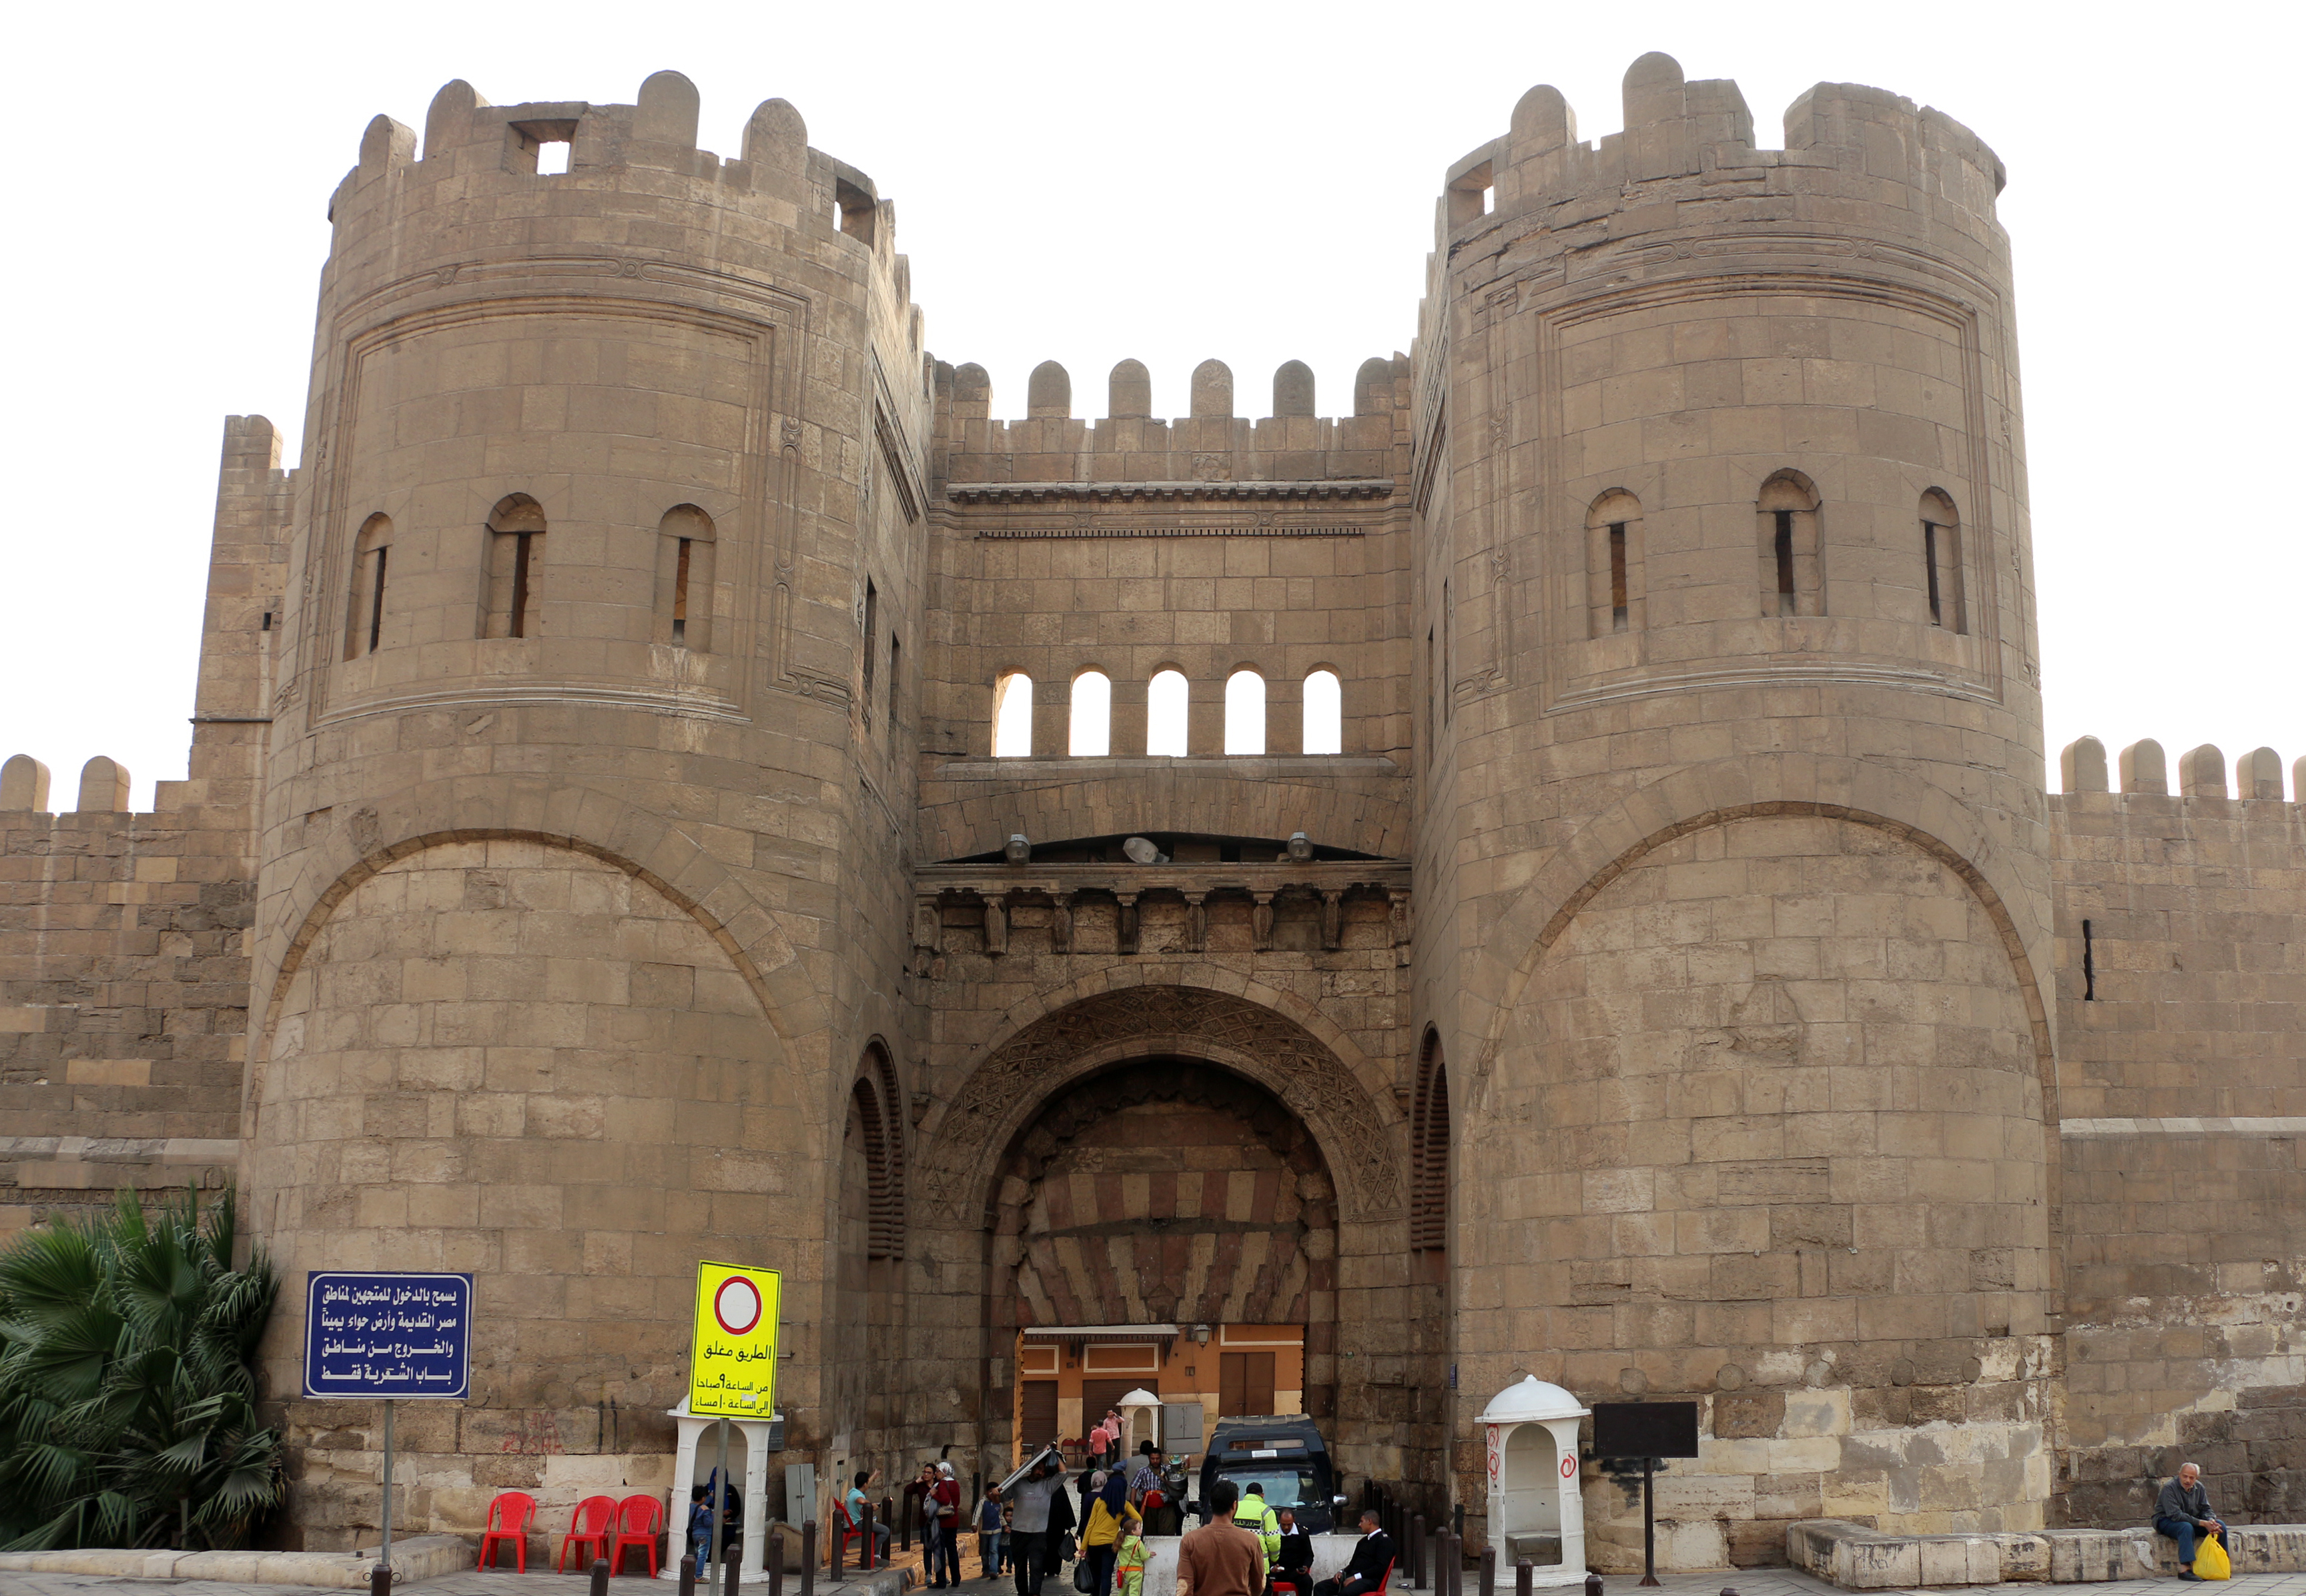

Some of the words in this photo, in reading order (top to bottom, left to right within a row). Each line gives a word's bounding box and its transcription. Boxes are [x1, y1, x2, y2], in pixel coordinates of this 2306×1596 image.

[322, 1284, 350, 1304] لمناطق
[351, 1285, 391, 1305] للمتجهين
[392, 1285, 430, 1306] بالدخول
[432, 1290, 457, 1307] يسمح
[322, 1307, 344, 1332] يميناً
[347, 1313, 369, 1331] حواء
[370, 1310, 396, 1332] وأرض
[398, 1311, 434, 1332] القديمة
[436, 1318, 456, 1332] مصر
[322, 1337, 366, 1358] مناطق
[367, 1340, 392, 1358] من
[394, 1338, 454, 1358] والخروج
[703, 1340, 733, 1359] مغلق
[735, 1344, 771, 1362] الطريق
[321, 1364, 362, 1380] فقط
[364, 1361, 414, 1385] الشعرية
[416, 1366, 452, 1385] باب
[725, 1379, 753, 1390] الساعة
[756, 1384, 768, 1394] من
[728, 1399, 755, 1409] الساعة
